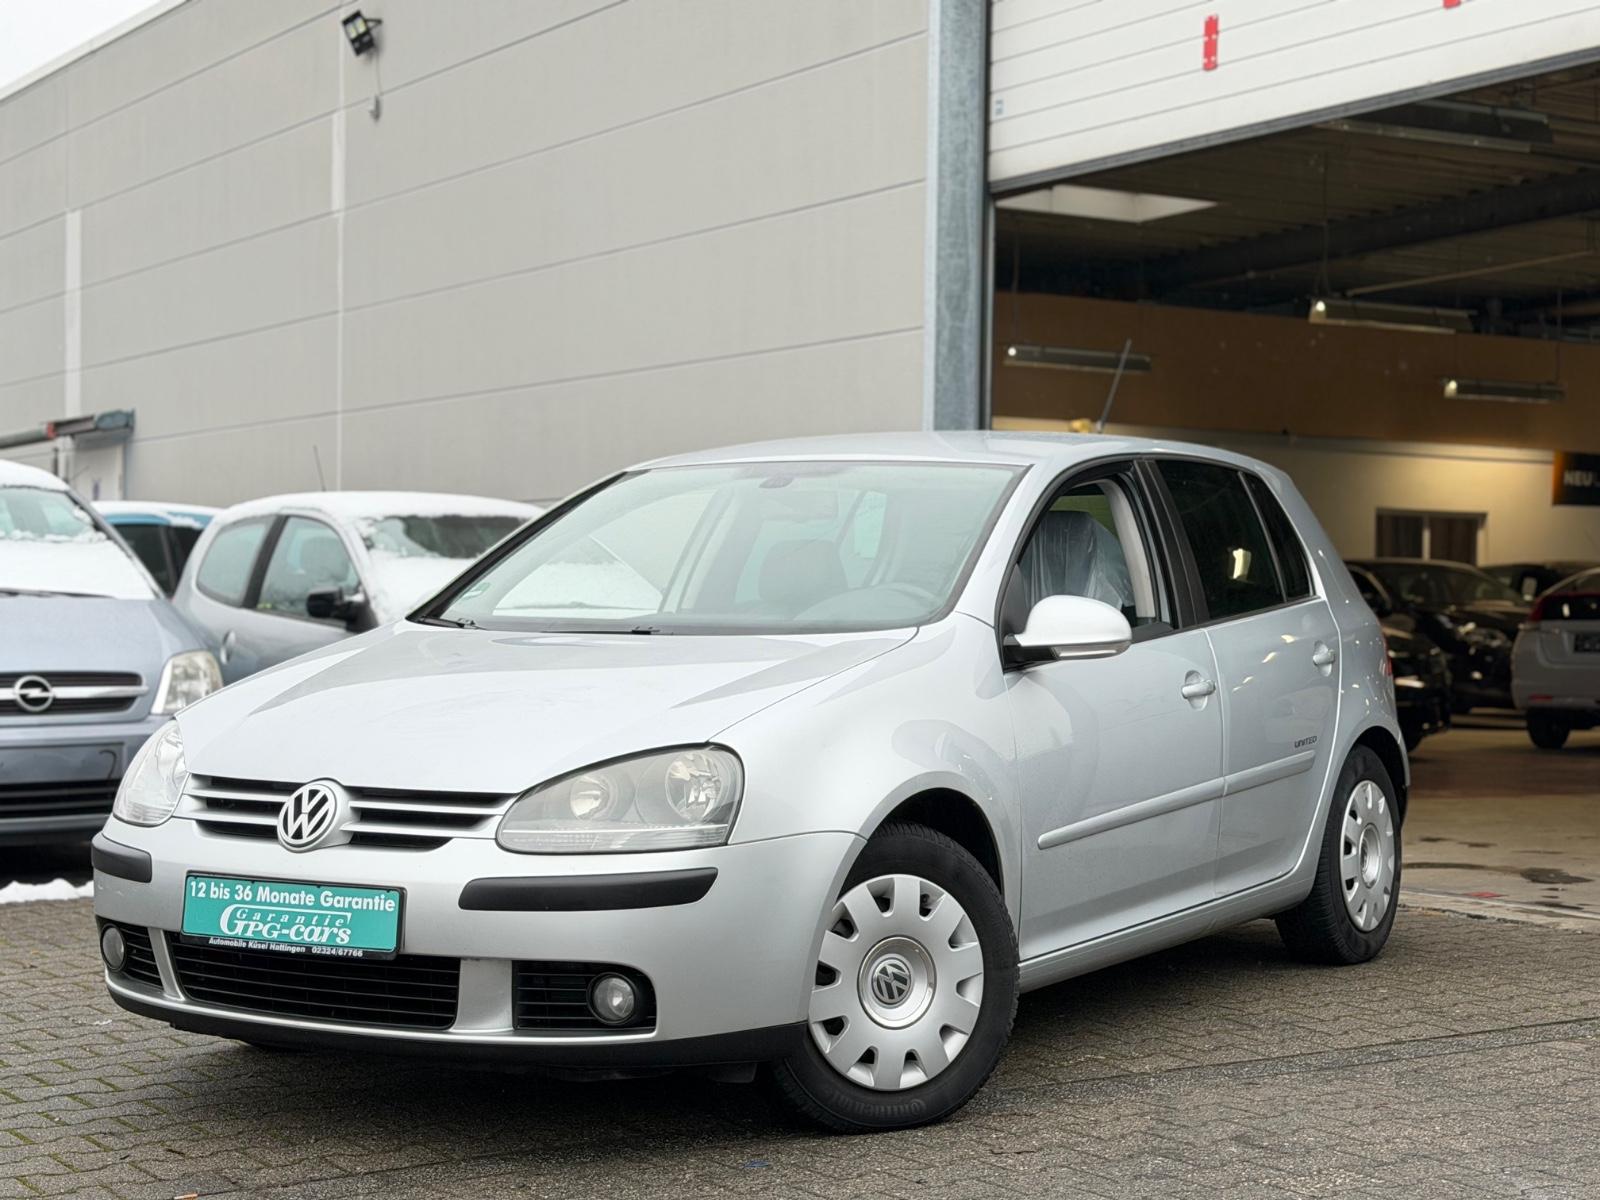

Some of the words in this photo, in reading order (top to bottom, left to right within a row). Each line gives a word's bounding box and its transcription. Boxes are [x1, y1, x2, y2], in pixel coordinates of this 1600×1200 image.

[190, 880, 206, 898] 12
[210, 885, 230, 900] bis
[234, 885, 252, 902] 36
[256, 886, 315, 905] Monate
[320, 891, 396, 912] Garantie
[236, 907, 345, 927] Garantie
[209, 937, 247, 948] Automobile
[269, 943, 305, 953] Hattingen
